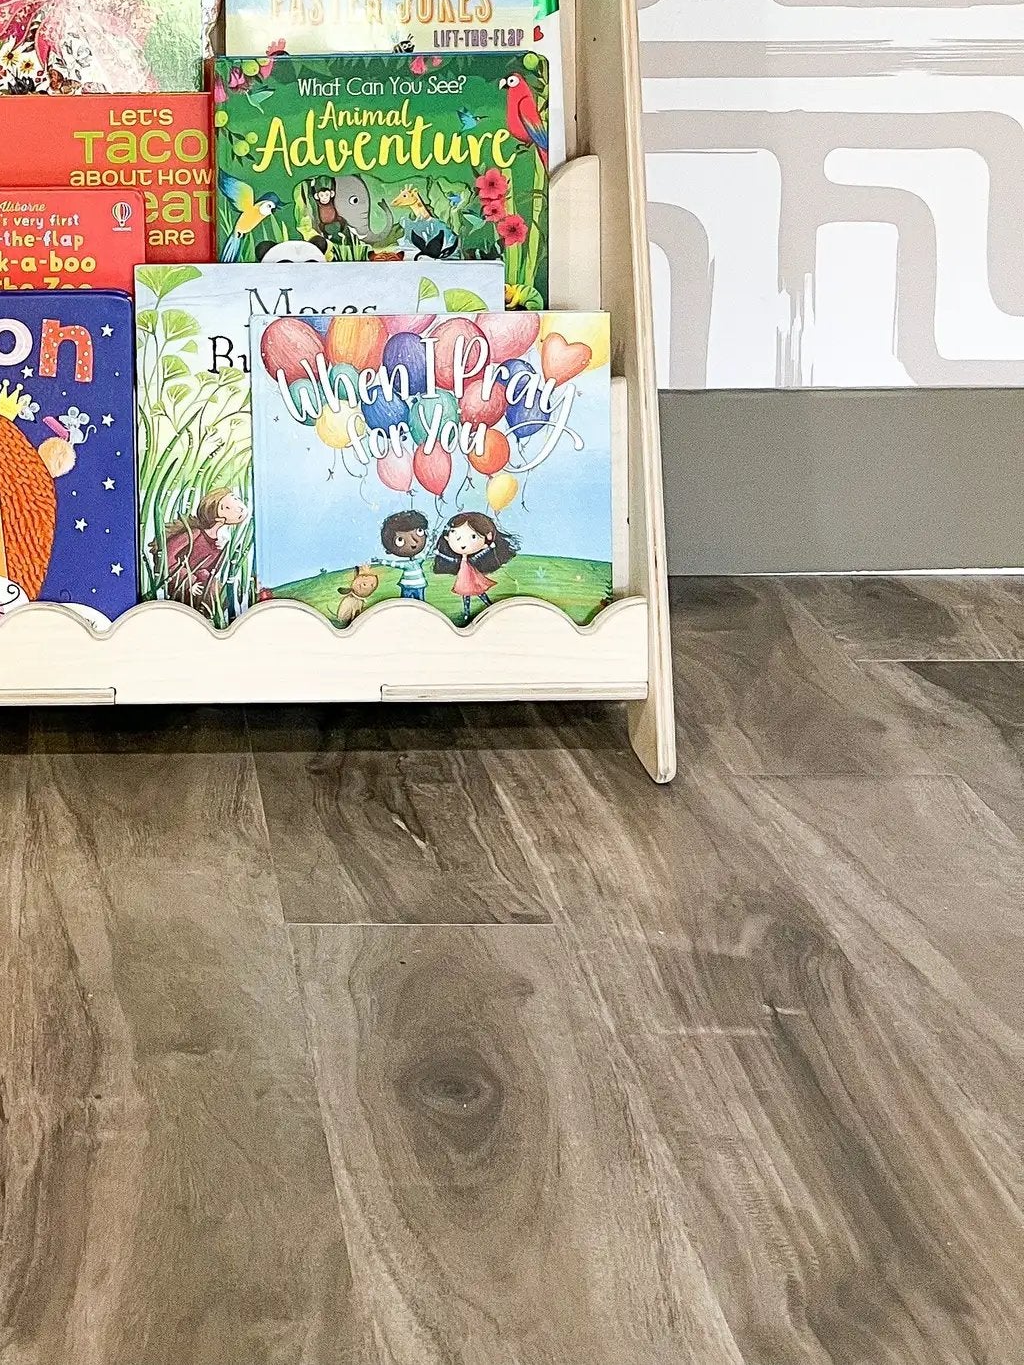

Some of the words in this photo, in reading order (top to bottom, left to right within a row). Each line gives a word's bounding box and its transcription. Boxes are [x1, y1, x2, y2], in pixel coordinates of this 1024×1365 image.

[298, 77, 340, 97] What
[345, 77, 385, 97] Can
[389, 76, 423, 96] You
[426, 75, 466, 95] See?
[318, 98, 413, 132] Animal
[252, 109, 520, 177] Adventure
[0, 200, 46, 212] Usborne
[14, 217, 44, 229] very
[49, 213, 80, 226] first
[276, 352, 409, 423] When
[420, 337, 439, 399] I
[453, 335, 585, 473] Pray
[348, 414, 410, 465] for
[418, 403, 488, 456] You
